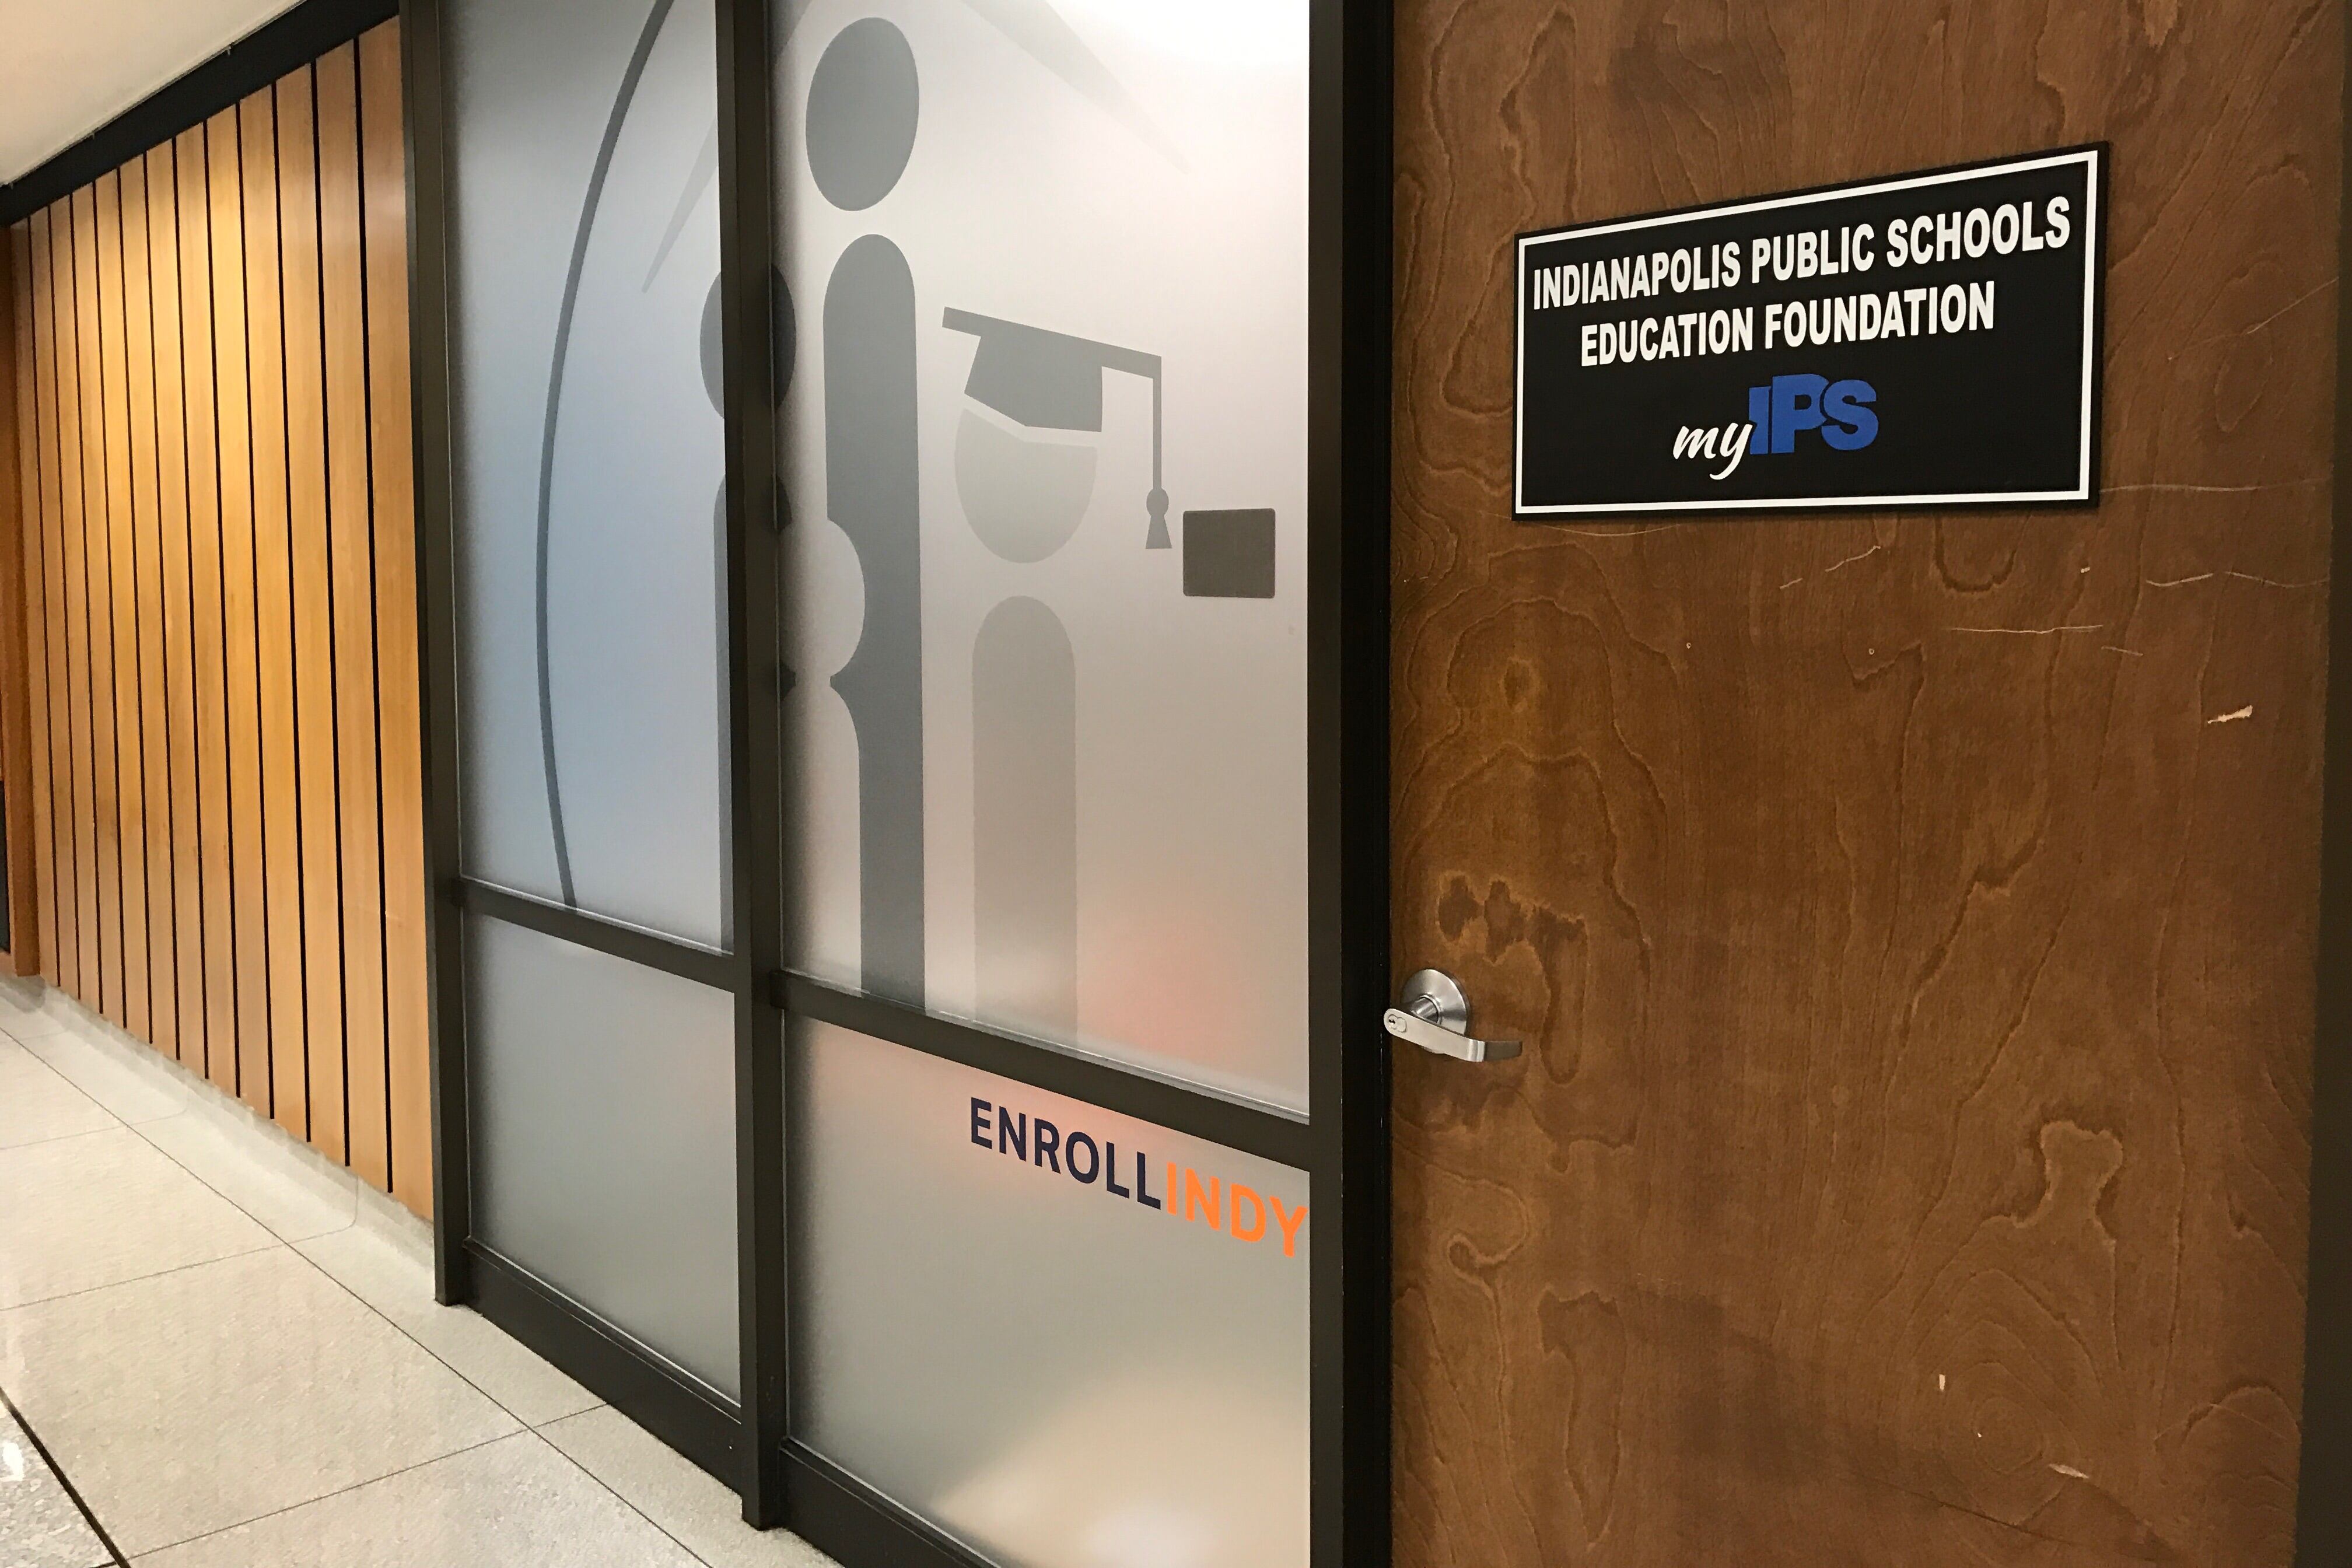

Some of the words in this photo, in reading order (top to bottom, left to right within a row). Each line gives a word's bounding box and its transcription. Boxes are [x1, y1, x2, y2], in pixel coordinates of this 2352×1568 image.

[1533, 242, 1741, 310] INDIANAPOLIS
[1751, 223, 1874, 284] PUBLIC
[1886, 195, 2070, 268] SCHOOLS
[1581, 306, 1754, 367] EDUCATION
[1765, 281, 1995, 349] FOUNDATION
